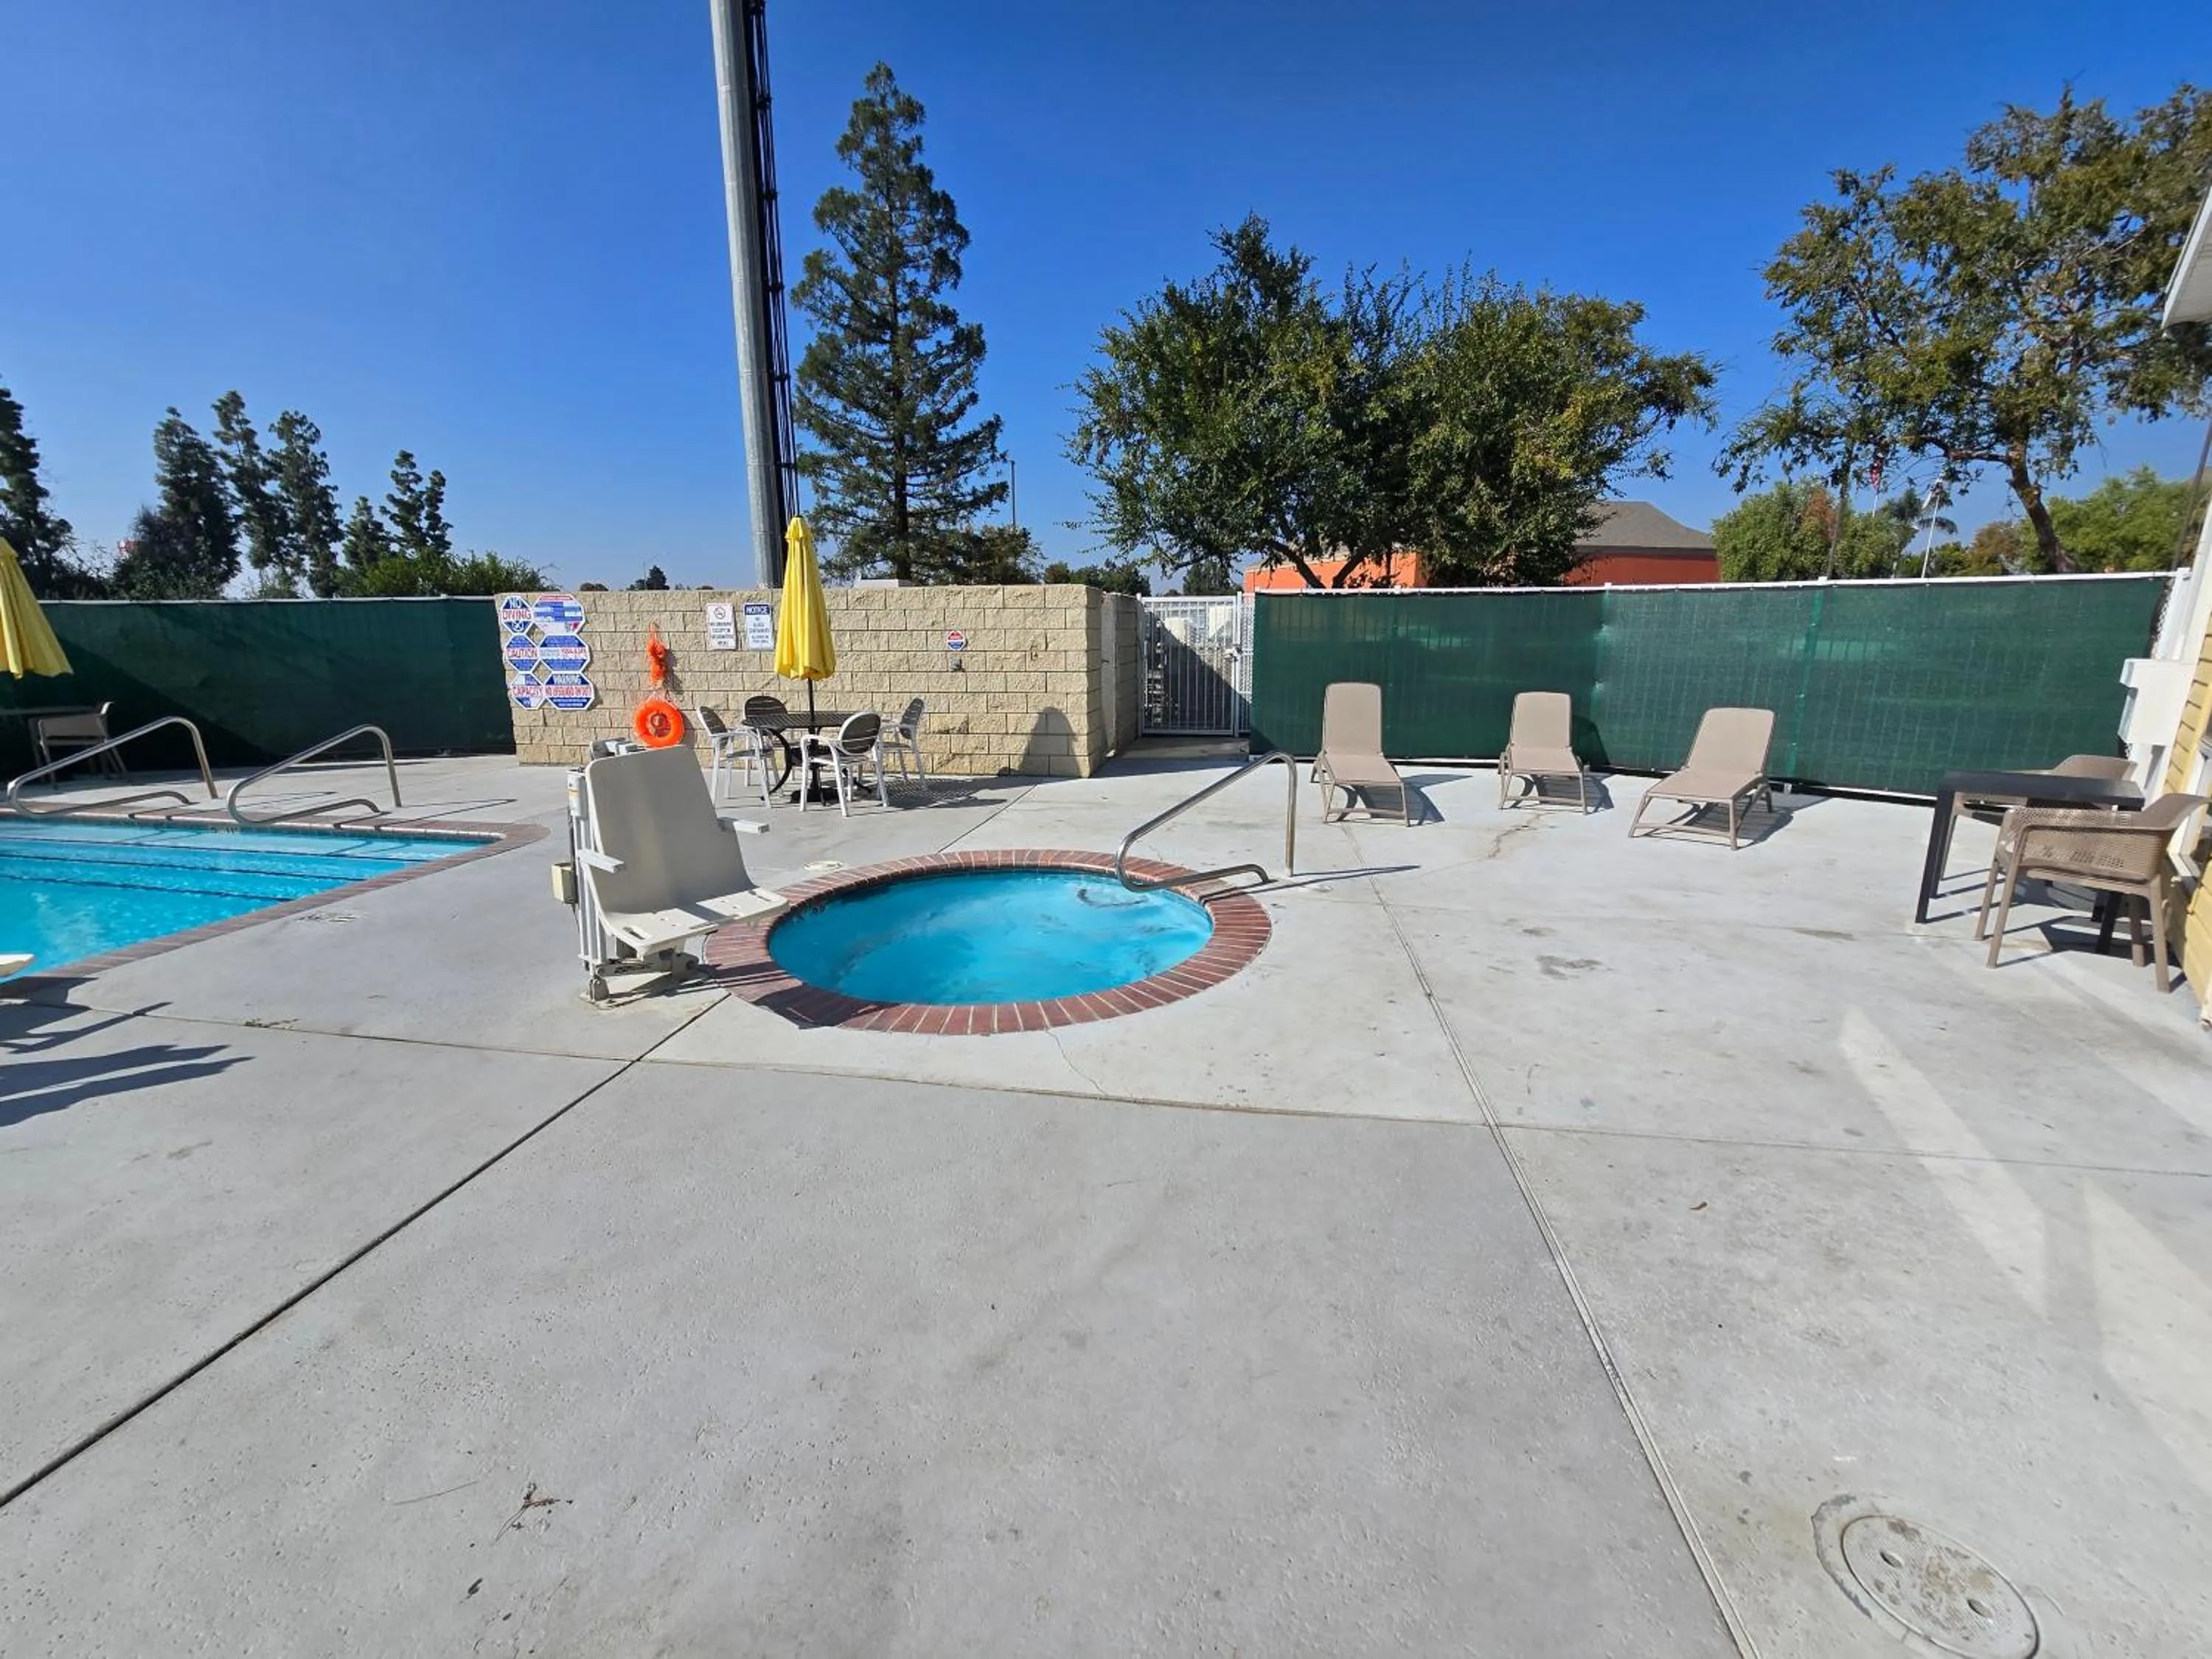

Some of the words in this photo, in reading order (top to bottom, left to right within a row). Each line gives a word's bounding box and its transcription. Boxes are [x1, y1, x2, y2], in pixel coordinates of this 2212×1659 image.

[510, 597, 521, 608] NO
[502, 610, 531, 619] DIVING
[746, 606, 768, 614] NOTICE
[507, 649, 537, 658] CAUTION
[554, 674, 581, 684] WARNING
[512, 686, 541, 696] CAPACITY
